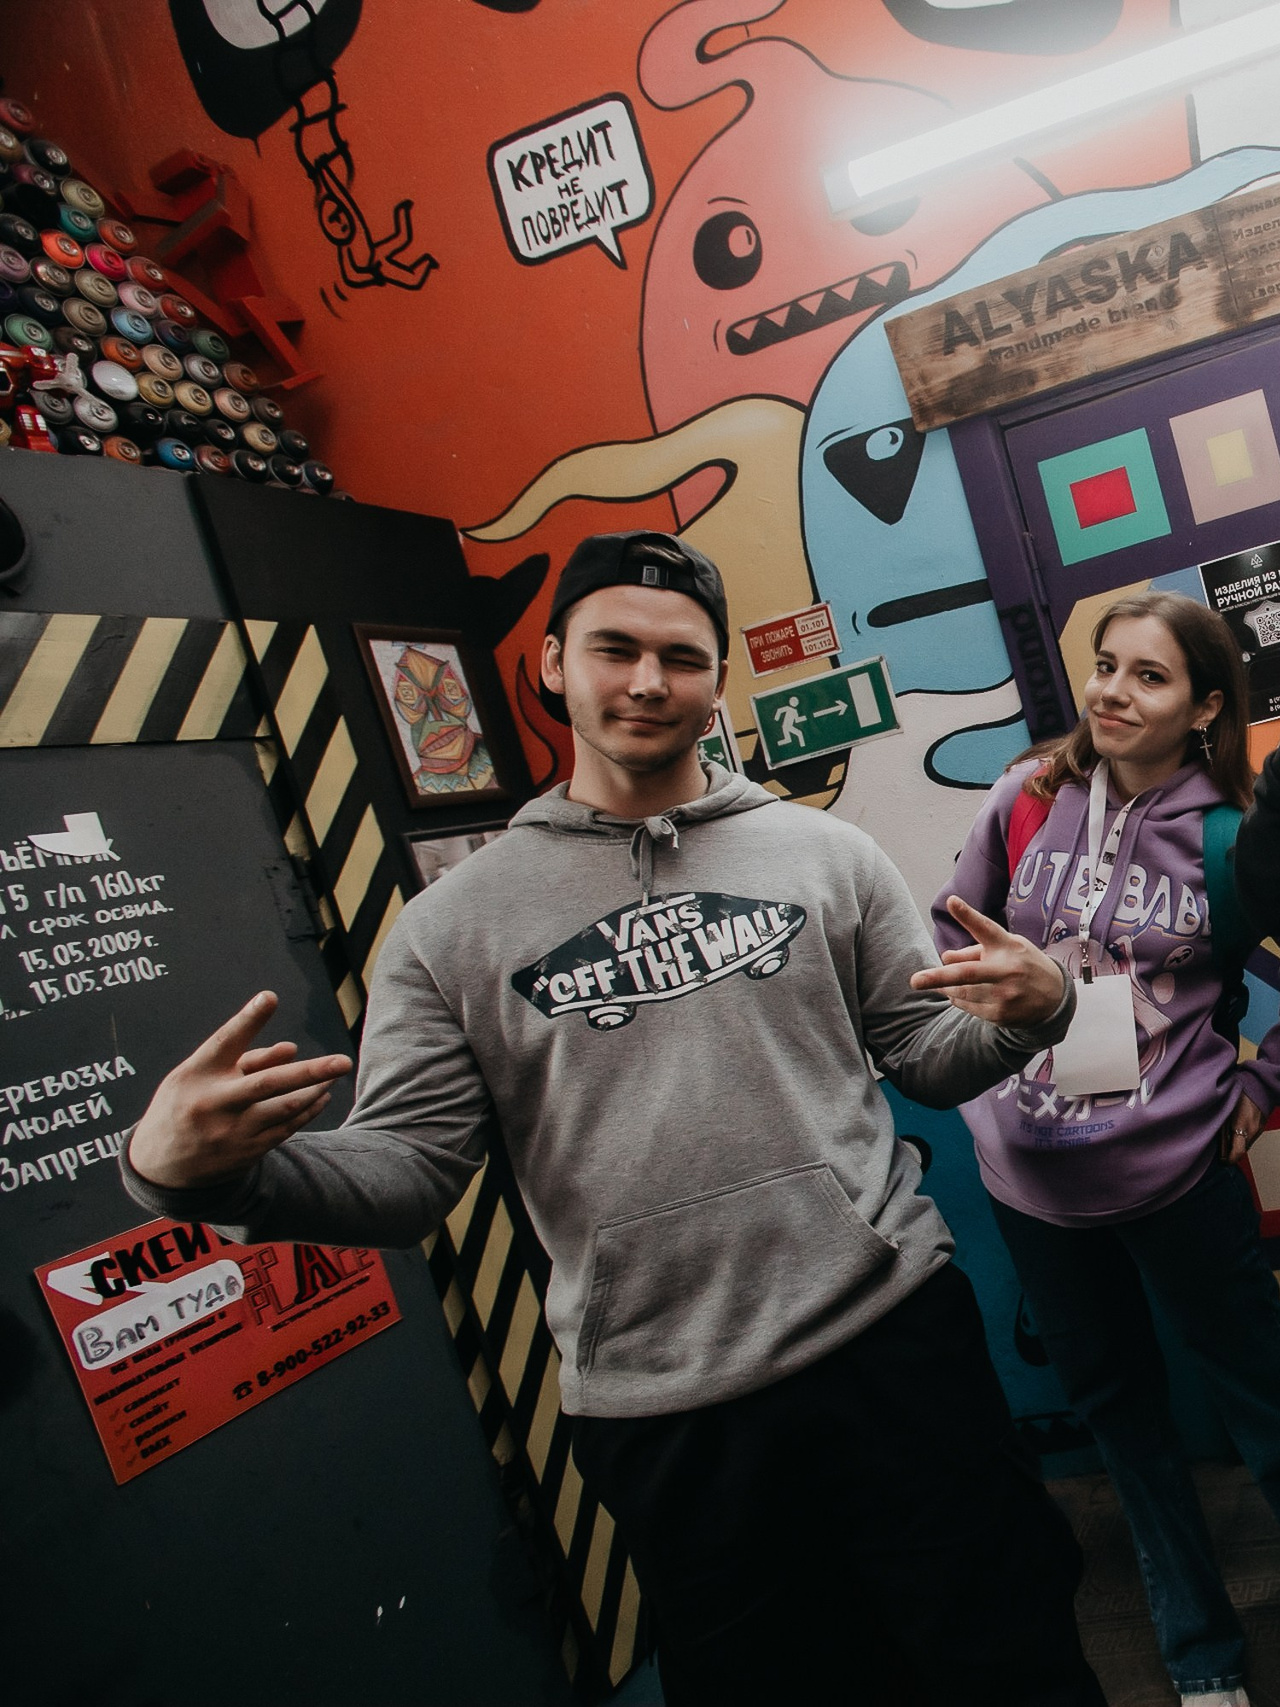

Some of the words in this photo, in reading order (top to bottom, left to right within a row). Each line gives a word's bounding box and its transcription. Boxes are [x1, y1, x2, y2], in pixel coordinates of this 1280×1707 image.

[507, 120, 616, 192] КРЕДИТ
[521, 179, 629, 251] ПОВРЕДИТ
[557, 176, 584, 199] НЕ
[942, 231, 1209, 356] ALYASKA
[988, 311, 1101, 363] handmade
[1214, 576, 1261, 597] ИЗДЕЛИЯ
[1262, 571, 1277, 583] ИЗ
[1216, 584, 1263, 608] РУЧНОЙ
[749, 636, 764, 649] ПРИ
[764, 625, 796, 646] ПОЖАРЕ
[759, 644, 794, 663] ЗВОНИТЬ
[1007, 851, 1090, 914] UTE
[596, 893, 704, 952] VANS
[618, 933, 703, 993] THE
[3, 1092, 113, 1146] ЛЮДЕЙ
[256, 1301, 392, 1388] 8-900-522-92-33
